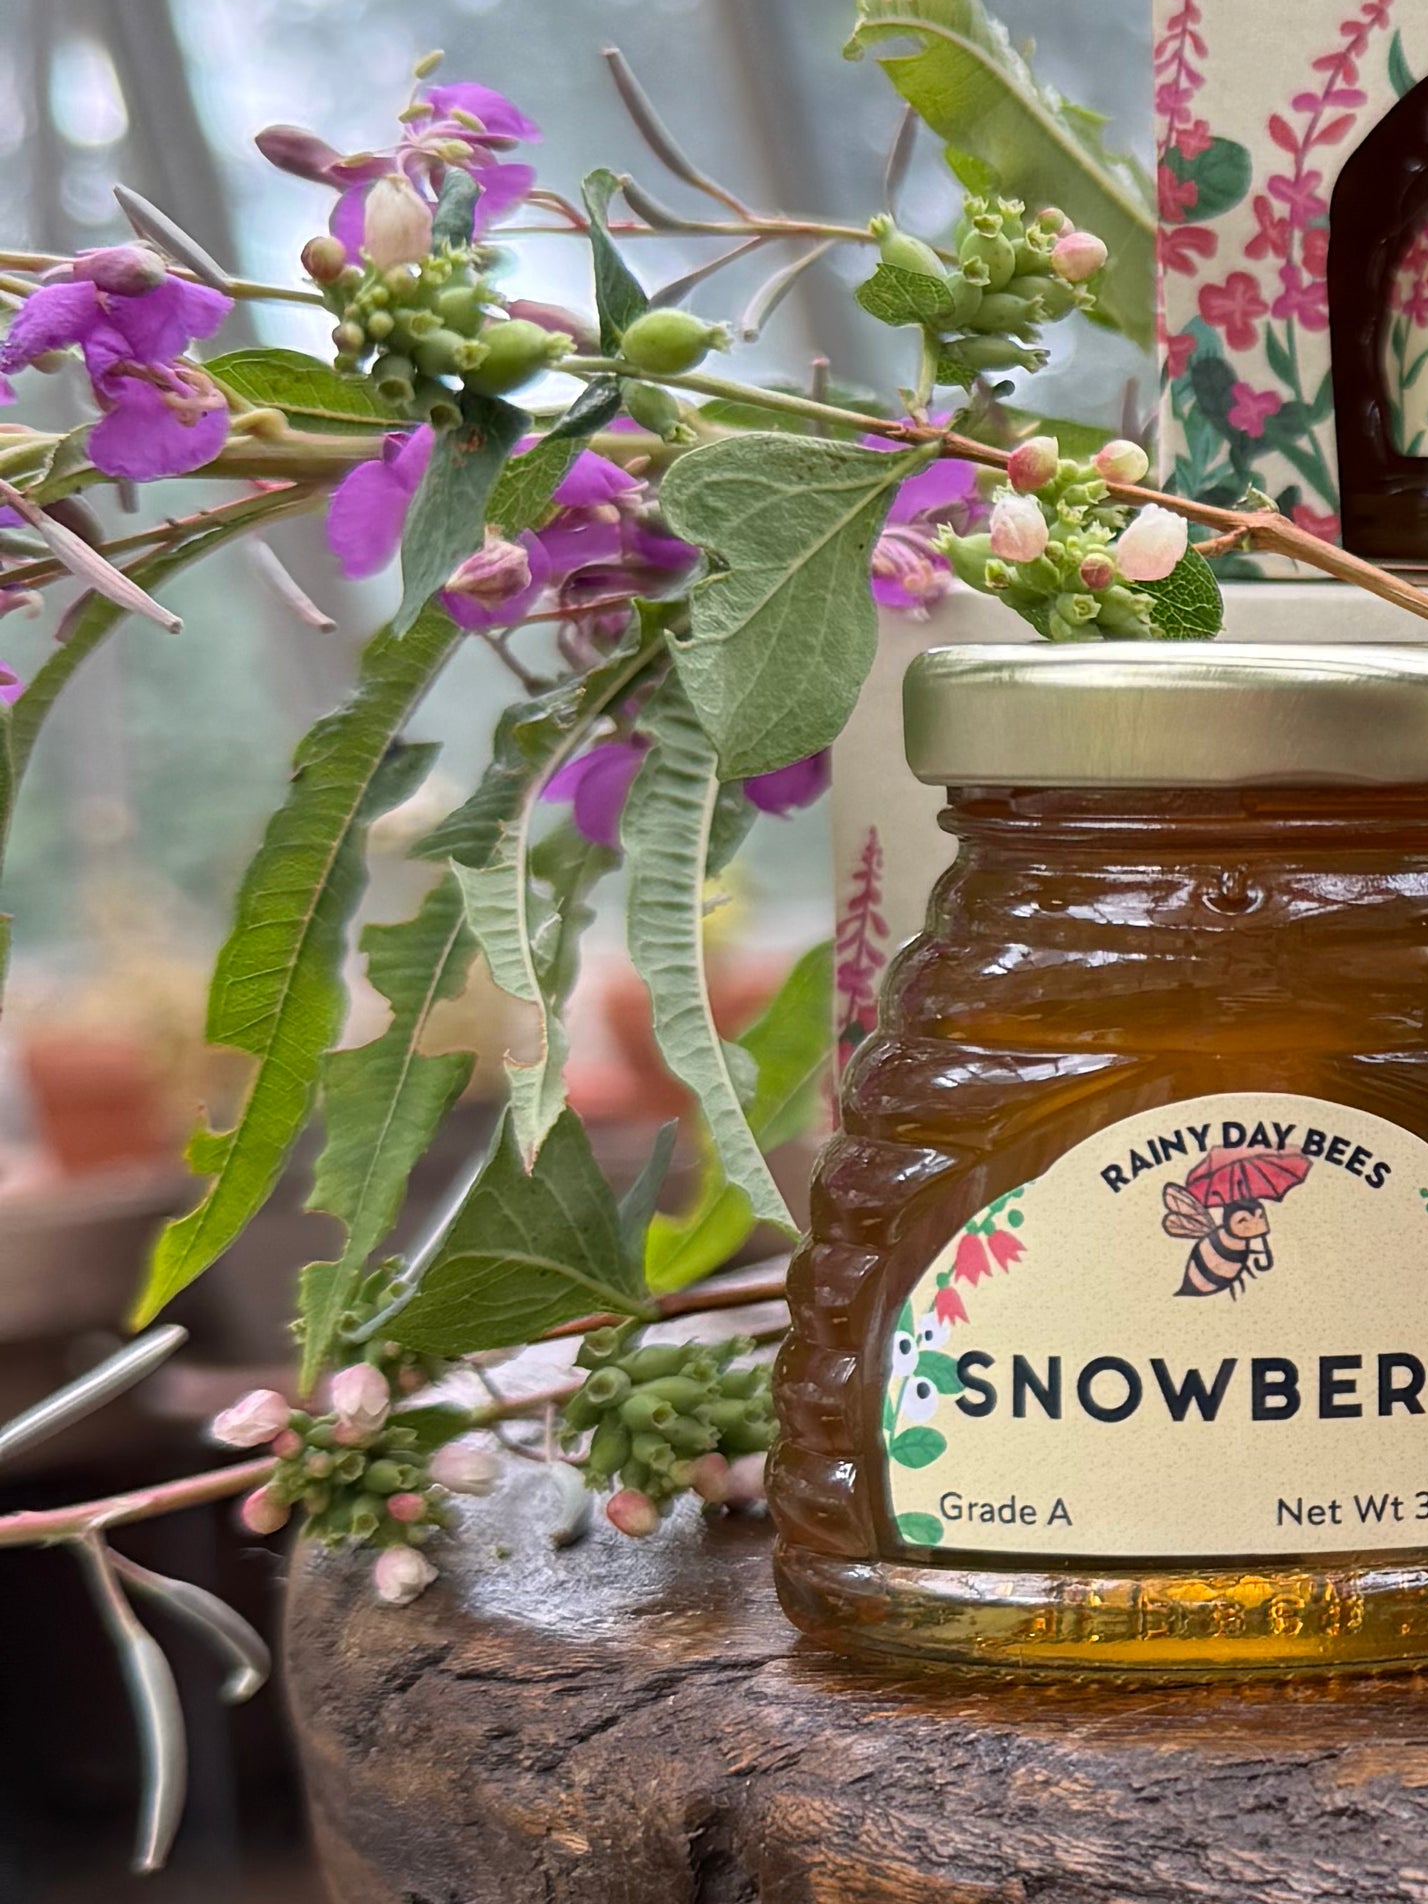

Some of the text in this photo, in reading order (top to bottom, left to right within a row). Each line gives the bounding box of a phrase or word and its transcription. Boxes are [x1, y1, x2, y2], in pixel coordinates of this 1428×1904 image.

[1100, 1121, 1392, 1193] RAINY DAY BEES
[939, 1491, 1073, 1526] Grade A
[1276, 1497, 1343, 1526] Net
[1353, 1493, 1405, 1524] Wt
